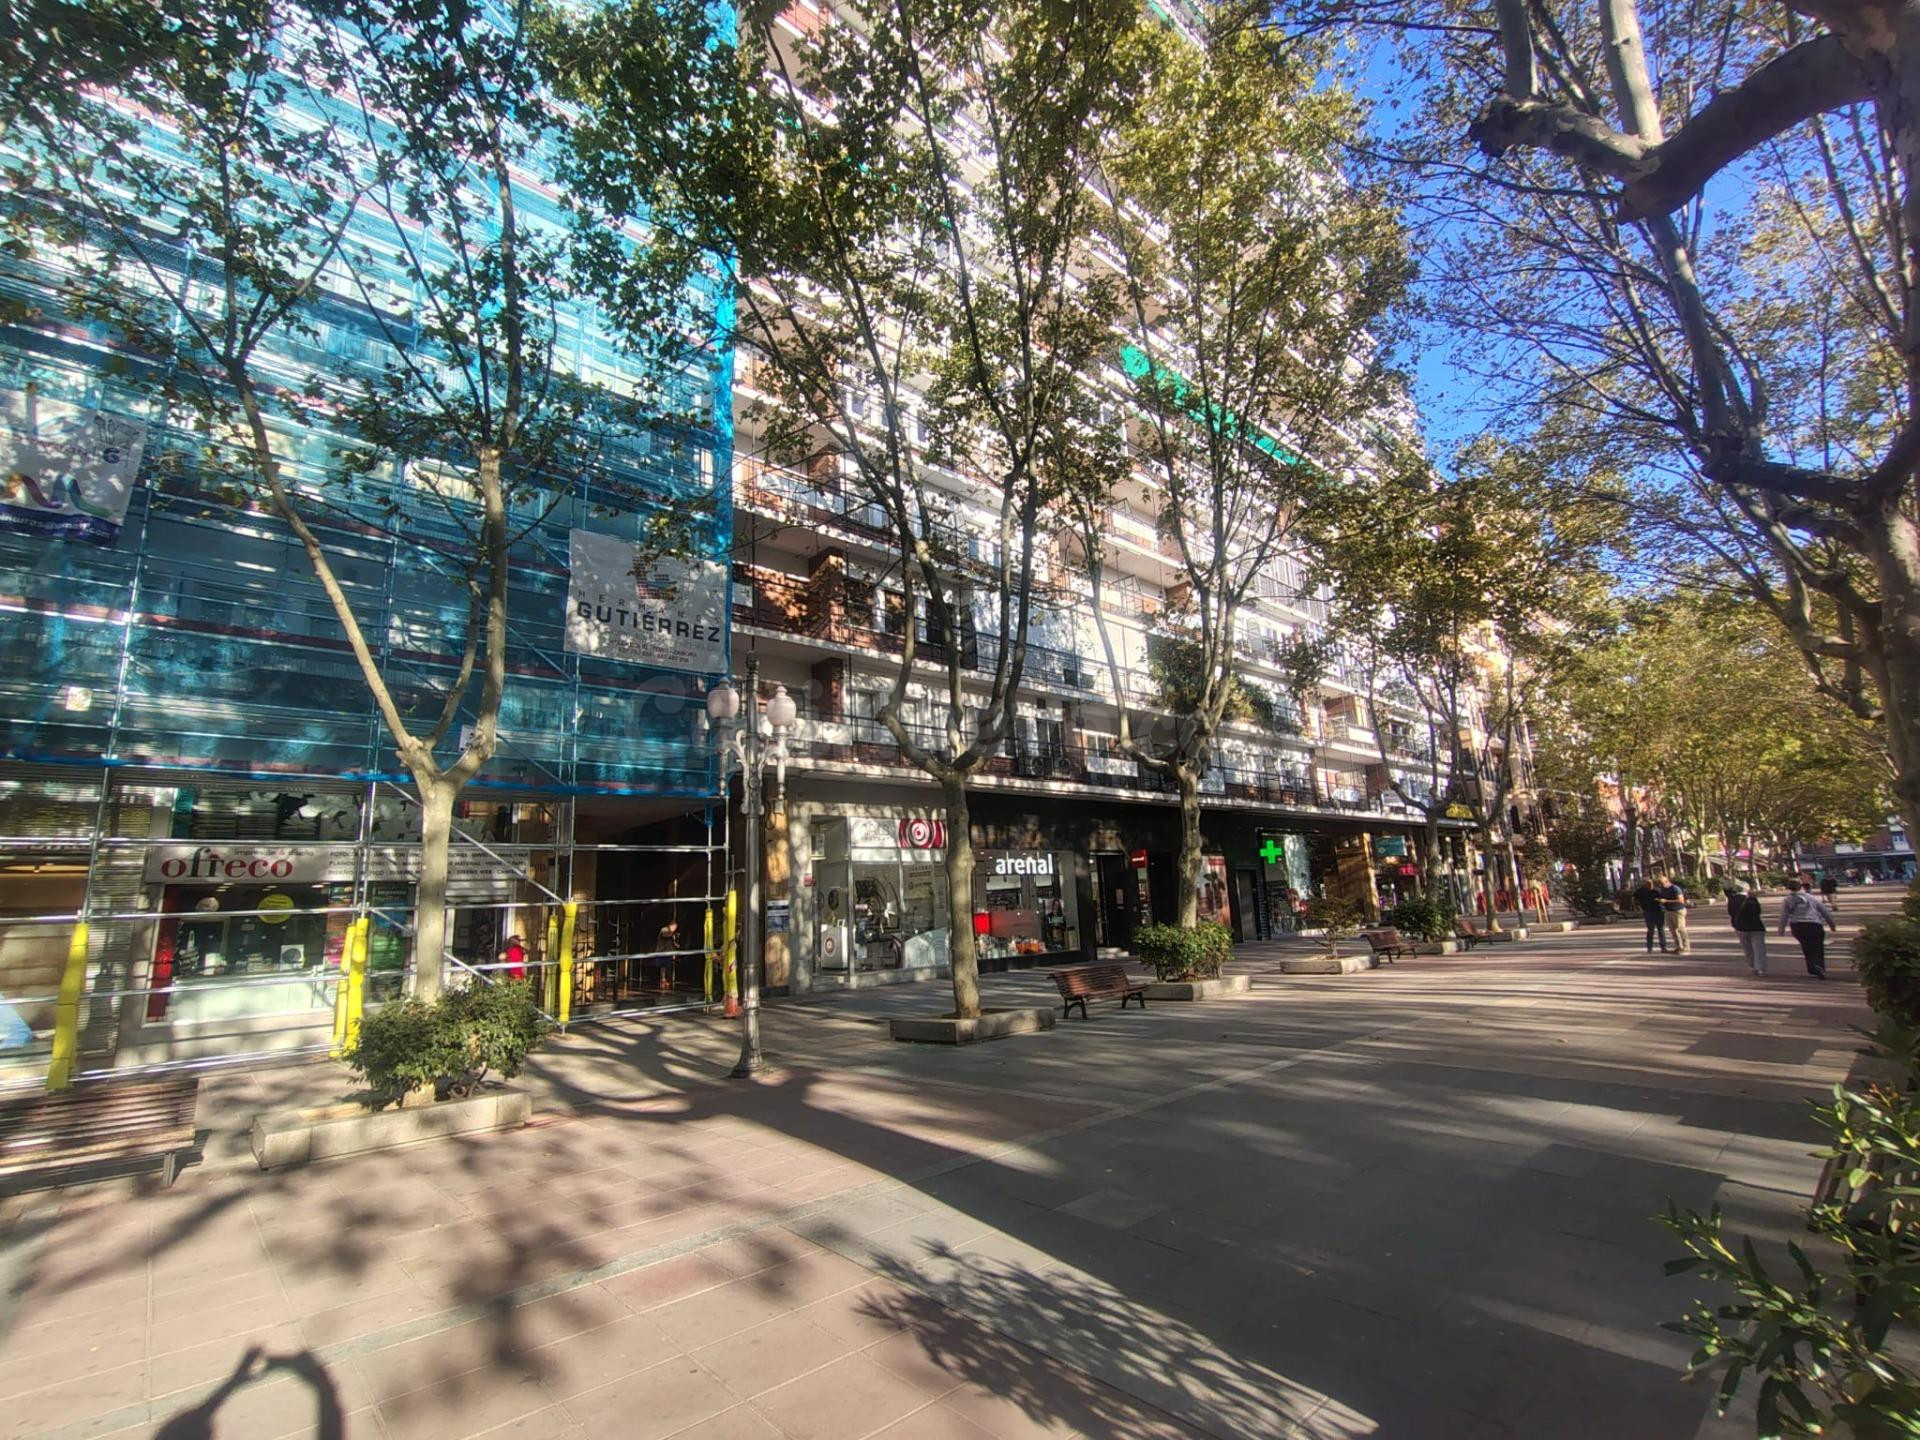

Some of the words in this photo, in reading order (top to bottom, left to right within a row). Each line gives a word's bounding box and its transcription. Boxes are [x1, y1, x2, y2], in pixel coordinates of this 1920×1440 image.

[577, 601, 721, 643] GUTIÉRREZ
[578, 589, 721, 625] HERMANOS
[995, 853, 1054, 875] arenal
